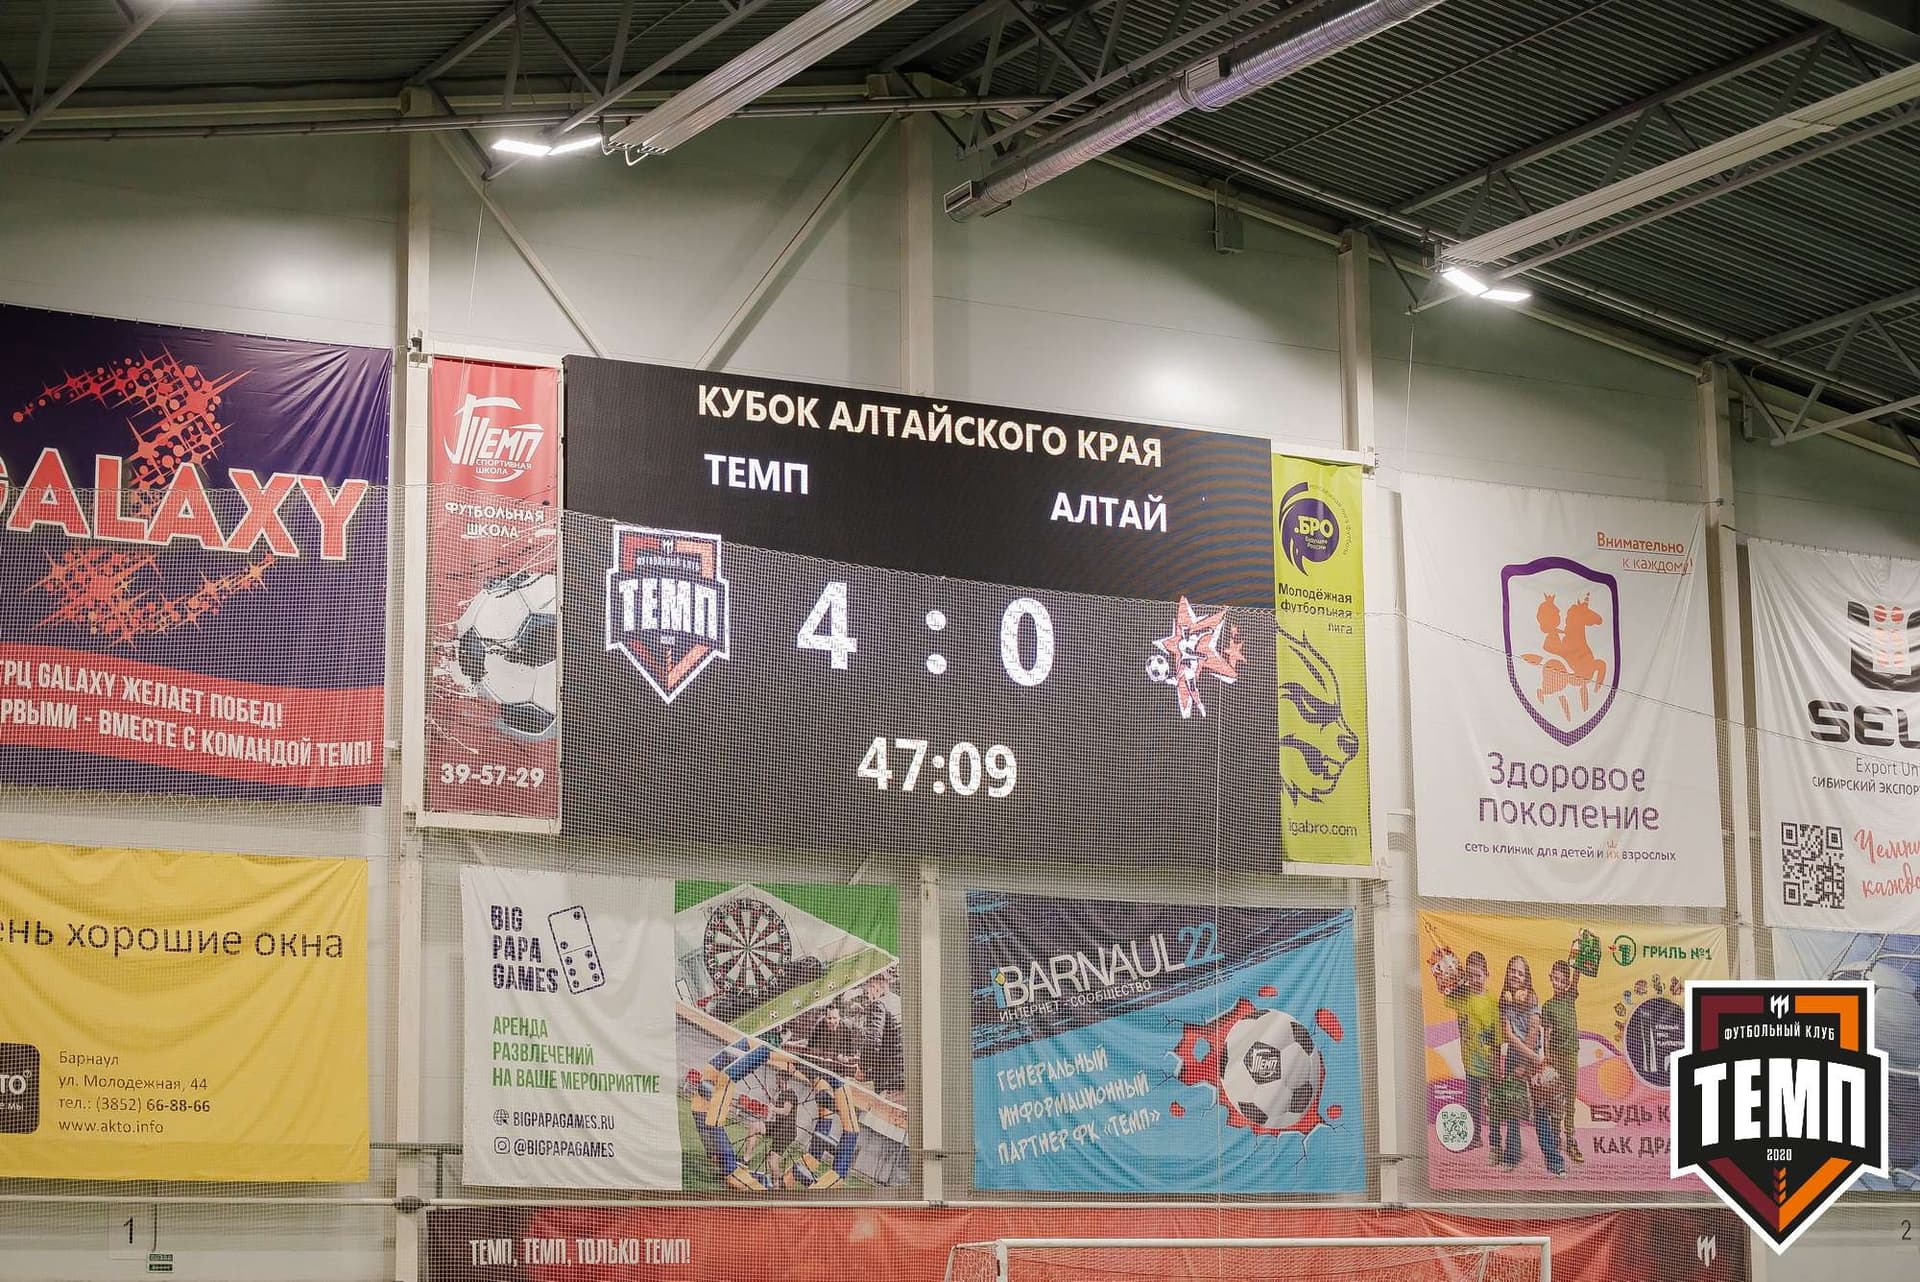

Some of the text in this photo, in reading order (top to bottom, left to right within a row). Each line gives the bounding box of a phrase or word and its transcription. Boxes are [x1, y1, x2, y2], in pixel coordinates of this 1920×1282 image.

[699, 384, 1163, 468] КУБОК АЛТАЙСКОГО КРАЯ
[475, 458, 532, 470] СПОРТИВНАЯ
[475, 467, 508, 475] ШКОЛА
[704, 453, 810, 495] ТЕМП
[0, 447, 369, 560] ALAXY
[445, 502, 544, 522] ФУТБОЛЬНАЯ
[1051, 491, 1168, 533] АЛТАЙ
[466, 522, 519, 538] ШКОЛА
[1597, 531, 1684, 554] Внимательно
[1278, 582, 1353, 604] Молодёжная
[618, 577, 718, 641] ТЕМП
[1280, 600, 1353, 619] футбольная
[797, 581, 857, 671] 4
[999, 597, 1055, 687] 0
[38, 662, 115, 697] GALAXY
[122, 676, 204, 715] ЖЕЛАЕТ
[210, 693, 283, 729] ПОБЕД!
[99, 709, 177, 748] ВМЕСТЕ
[183, 725, 195, 750] С
[202, 729, 312, 767] КОМАНДОЙ
[317, 740, 372, 767] ТЕМП!
[440, 763, 545, 789] 39-57-29
[856, 736, 1018, 798] 47:09
[1487, 751, 1646, 793] Здоровое
[1856, 757, 1897, 776] Export
[1812, 776, 1920, 796] СИБИРСКИЙ ЭКСПОР
[1479, 797, 1660, 831] поколение
[1465, 842, 1489, 854] сеть
[1492, 844, 1534, 856] клиник
[1537, 847, 1558, 858] для
[1561, 846, 1594, 859] детей
[1622, 850, 1676, 862] взрослых
[491, 905, 523, 931] BIG
[67, 922, 242, 957] хорошие
[255, 931, 344, 958] окна
[493, 935, 541, 963] PAPA
[1643, 945, 1712, 960] ГРИЛЬ №1
[493, 963, 558, 993] GAMES
[493, 1016, 548, 1038] АРЕНДА
[59, 1050, 119, 1068] Барнаул
[493, 1042, 594, 1065] РАЗВЛЕЧЕНИЙ
[492, 1067, 660, 1094] НА ВАШЕ МЕРОПРИЯТИЕ
[997, 1044, 1108, 1091] ГЕНЕРАЛЬНЫЙ
[59, 1074, 208, 1093] ул. Молодежная, 44
[60, 1097, 211, 1114] тел.: (3852) 66-88-66
[998, 1070, 1149, 1130] ИНФОРМАЦИОННЫЙ
[59, 1120, 163, 1134] www.akto.info
[513, 1111, 615, 1130] BIGPAPAGAMES.RU
[513, 1138, 615, 1158] @BIGPAPAGAMES
[998, 1108, 1160, 1165] ПАРТНЕР ФК «ТЕМП»
[1593, 1136, 1633, 1155] КАК
[123, 1216, 133, 1244] 1
[1901, 1219, 1912, 1241] 2
[469, 1237, 691, 1267] ТЕМП, ТЕМП, ТОЛЬКО ТЕМП!
